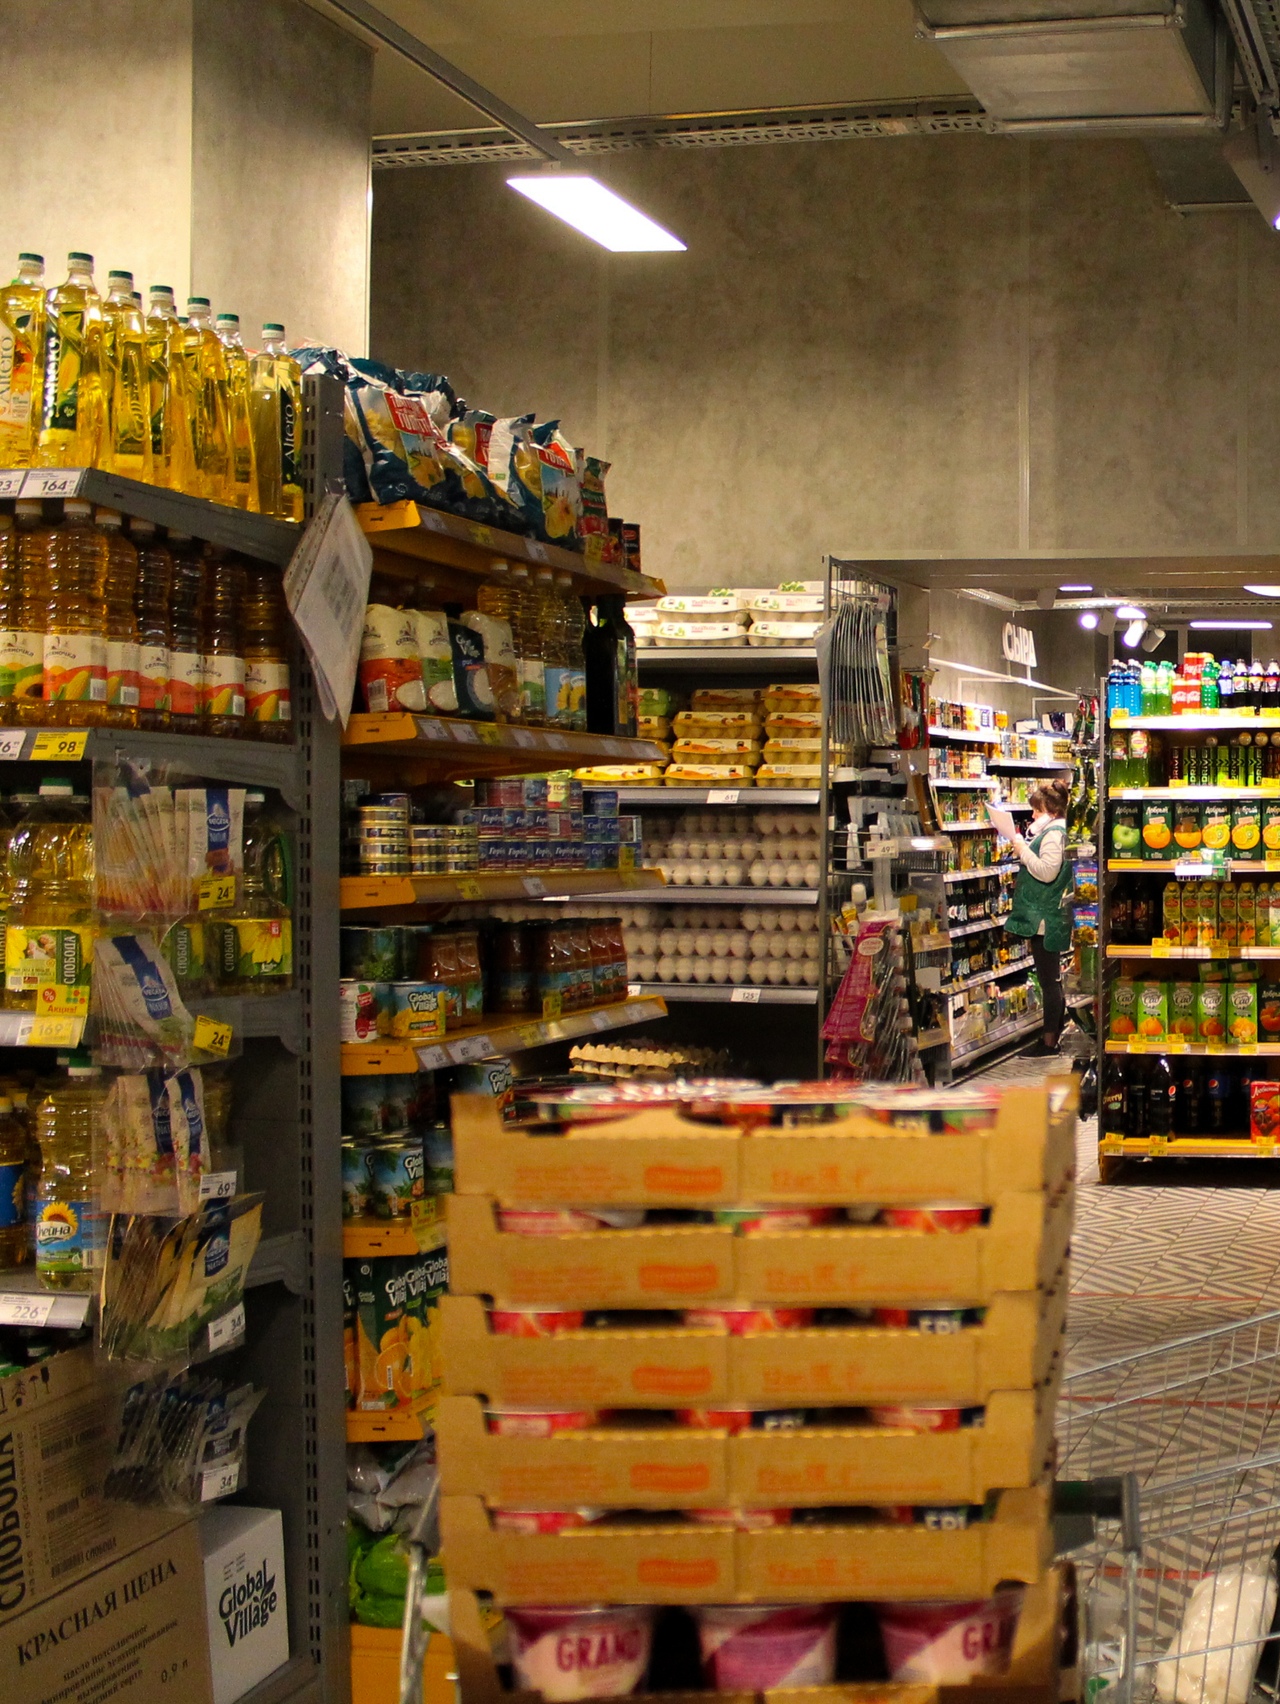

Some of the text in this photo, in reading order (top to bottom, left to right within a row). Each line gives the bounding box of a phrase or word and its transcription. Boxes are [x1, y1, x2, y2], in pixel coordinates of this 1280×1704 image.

[285, 404, 300, 461] Altero
[43, 481, 68, 491] 164
[58, 741, 77, 753] 98
[1145, 805, 1169, 815] Добрый
[217, 887, 229, 900] 24
[177, 930, 187, 976] СЛОБОДА
[225, 927, 233, 972] СЛОБОДА
[64, 935, 76, 985] СЛОБОДА
[409, 991, 434, 1002] Global
[742, 992, 755, 1000] 125
[47, 1004, 77, 1014] Акция!
[212, 1031, 224, 1047] 24
[217, 1183, 230, 1196] 69
[14, 1305, 39, 1319] 226
[219, 1558, 268, 1620] Global
[16, 1591, 118, 1667] КРАСНАЯ
[123, 1558, 178, 1605] ЦЕНА
[224, 1591, 277, 1648] Village
